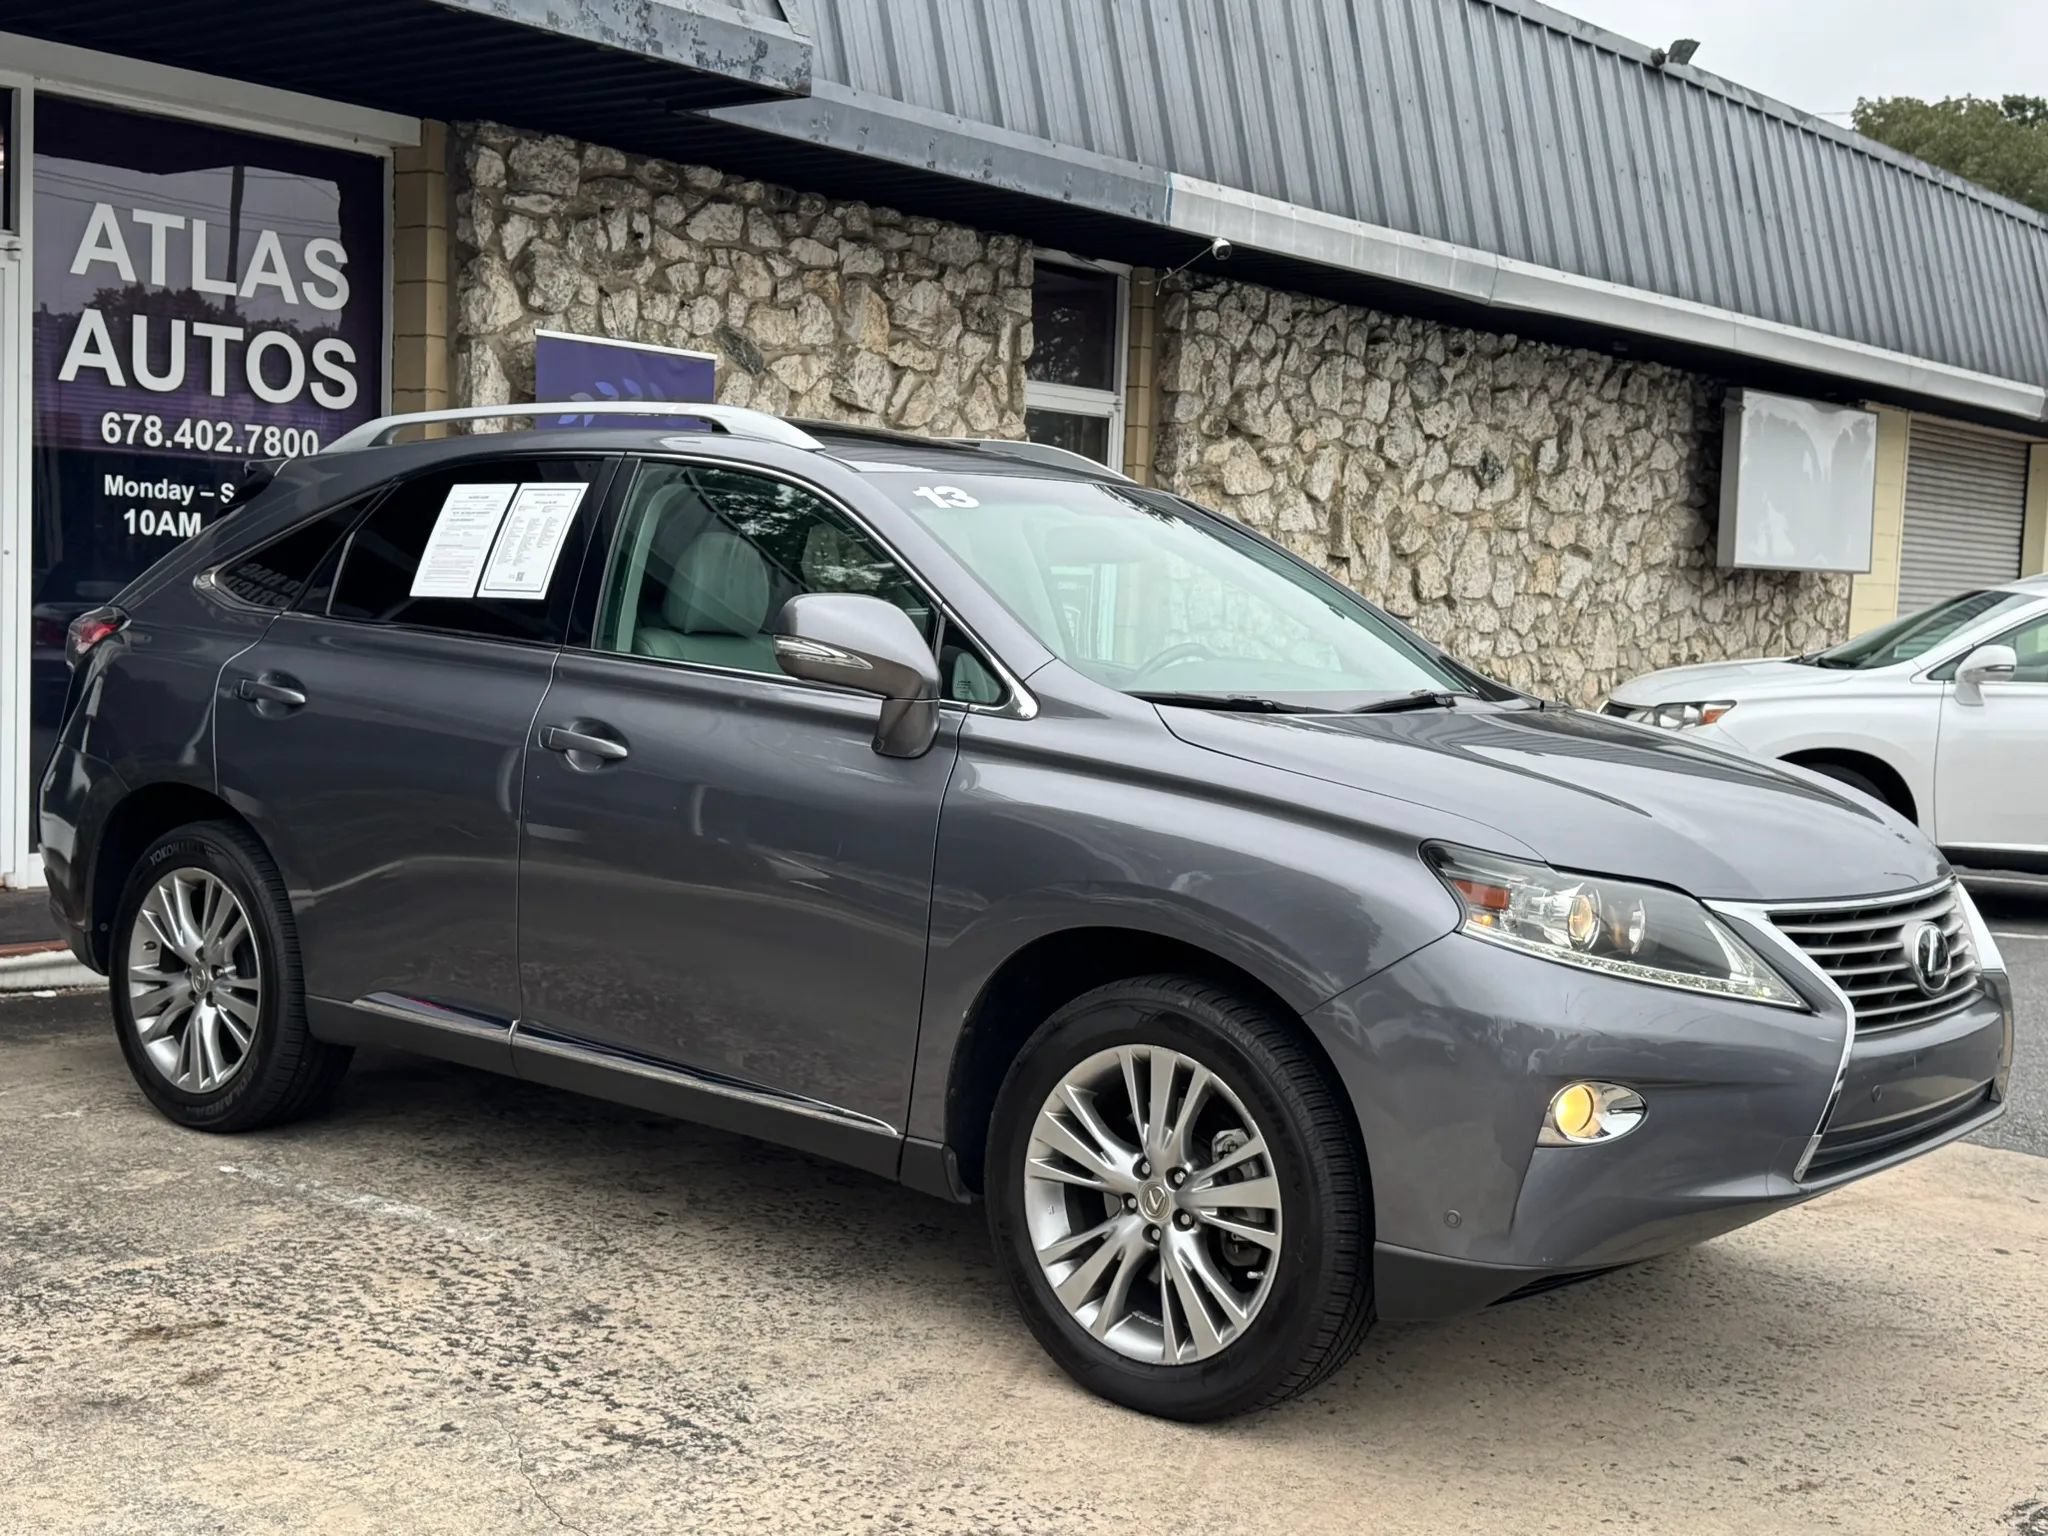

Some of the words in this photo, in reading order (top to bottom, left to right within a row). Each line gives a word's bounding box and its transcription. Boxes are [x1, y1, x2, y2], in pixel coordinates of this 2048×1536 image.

[70, 202, 350, 311] ATLAS
[58, 308, 358, 410] AUTOS
[101, 411, 319, 457] 678.402.7800
[104, 473, 195, 506] Monday
[912, 486, 980, 509] 13
[123, 508, 201, 538] 10AM
